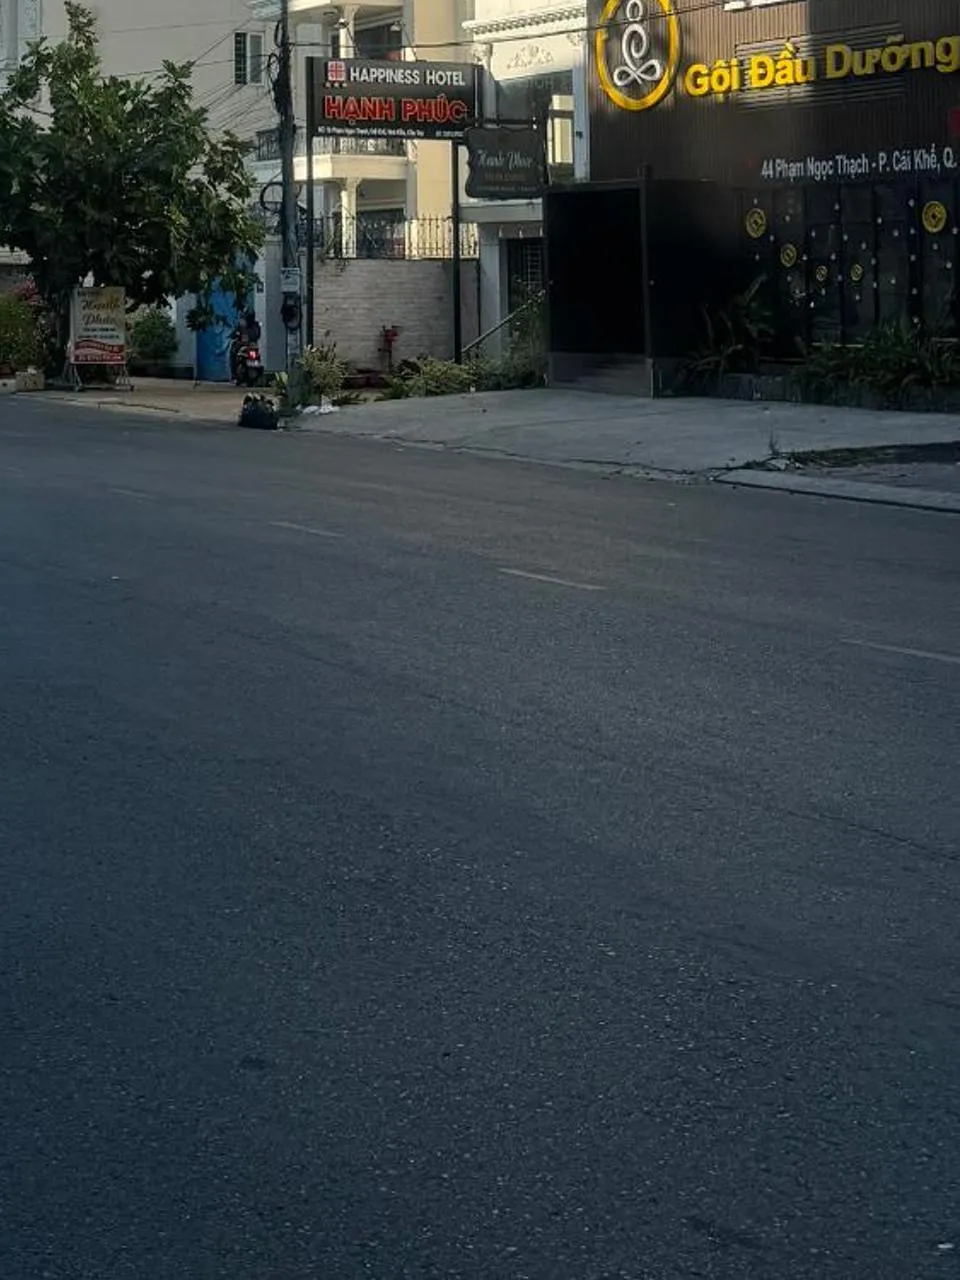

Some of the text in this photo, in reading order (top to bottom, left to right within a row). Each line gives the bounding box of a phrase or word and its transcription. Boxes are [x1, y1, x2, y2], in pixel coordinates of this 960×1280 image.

[349, 67, 466, 86] HAPPINESS HOTEL
[750, 42, 816, 89] Đầu
[826, 34, 960, 79] Dưỡng
[325, 93, 468, 125] HẠNH PHÚC
[761, 159, 773, 179] 44
[775, 158, 804, 182] Phạm
[806, 155, 834, 182] Ngọc
[835, 153, 869, 179] Thạch
[879, 151, 891, 174] P.
[893, 150, 912, 172] Cái
[943, 147, 958, 169] Q.
